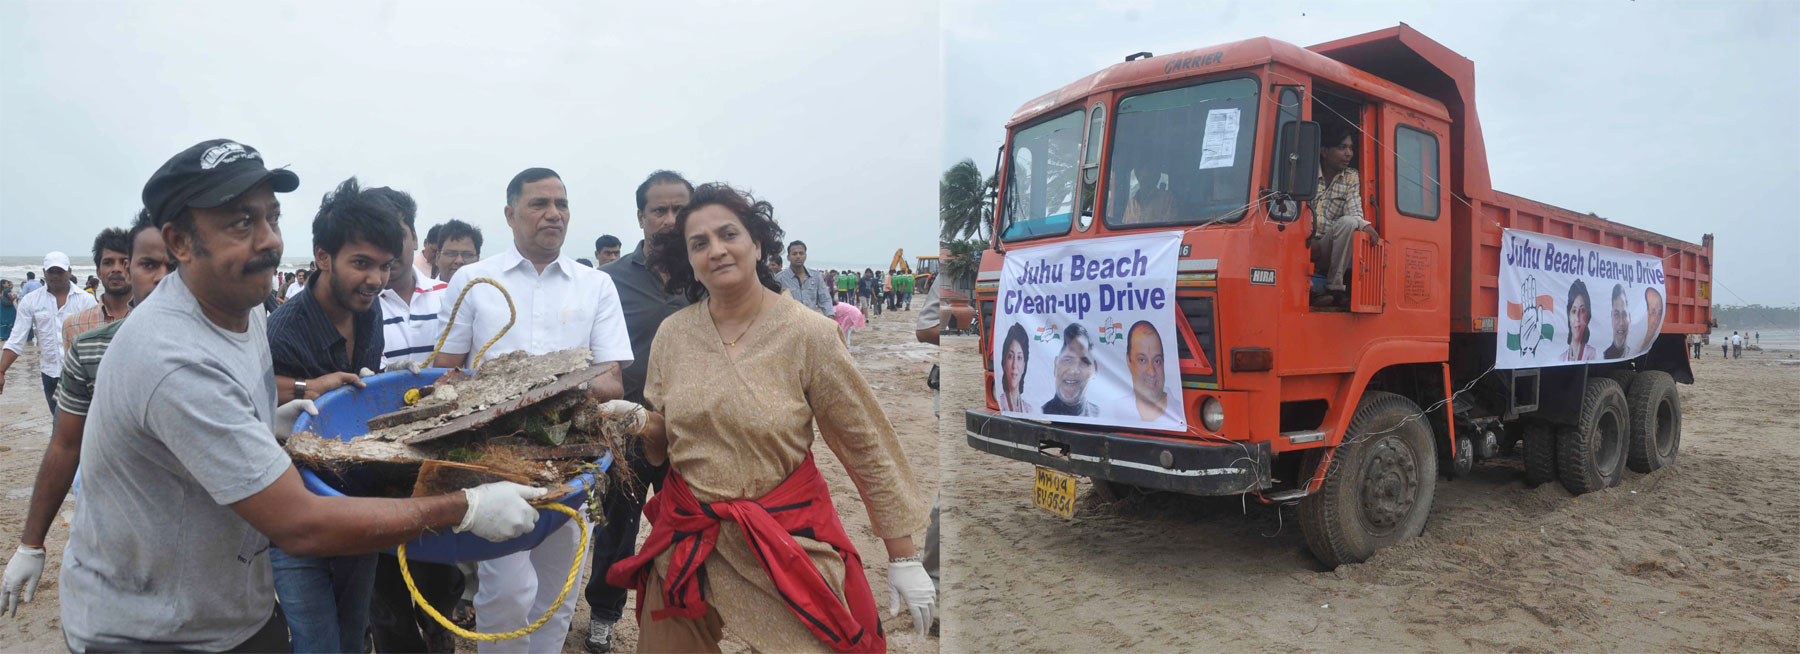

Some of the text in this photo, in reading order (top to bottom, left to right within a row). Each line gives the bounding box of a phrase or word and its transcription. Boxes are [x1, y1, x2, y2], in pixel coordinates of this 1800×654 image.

[1165, 51, 1224, 74] CARRIER
[1016, 249, 1148, 285] Juhu Beach
[1253, 270, 1274, 283] HIRA
[1506, 236, 1665, 288] Juhu Beach Clean-up Drive
[1004, 282, 1166, 320] Clean-up Drive
